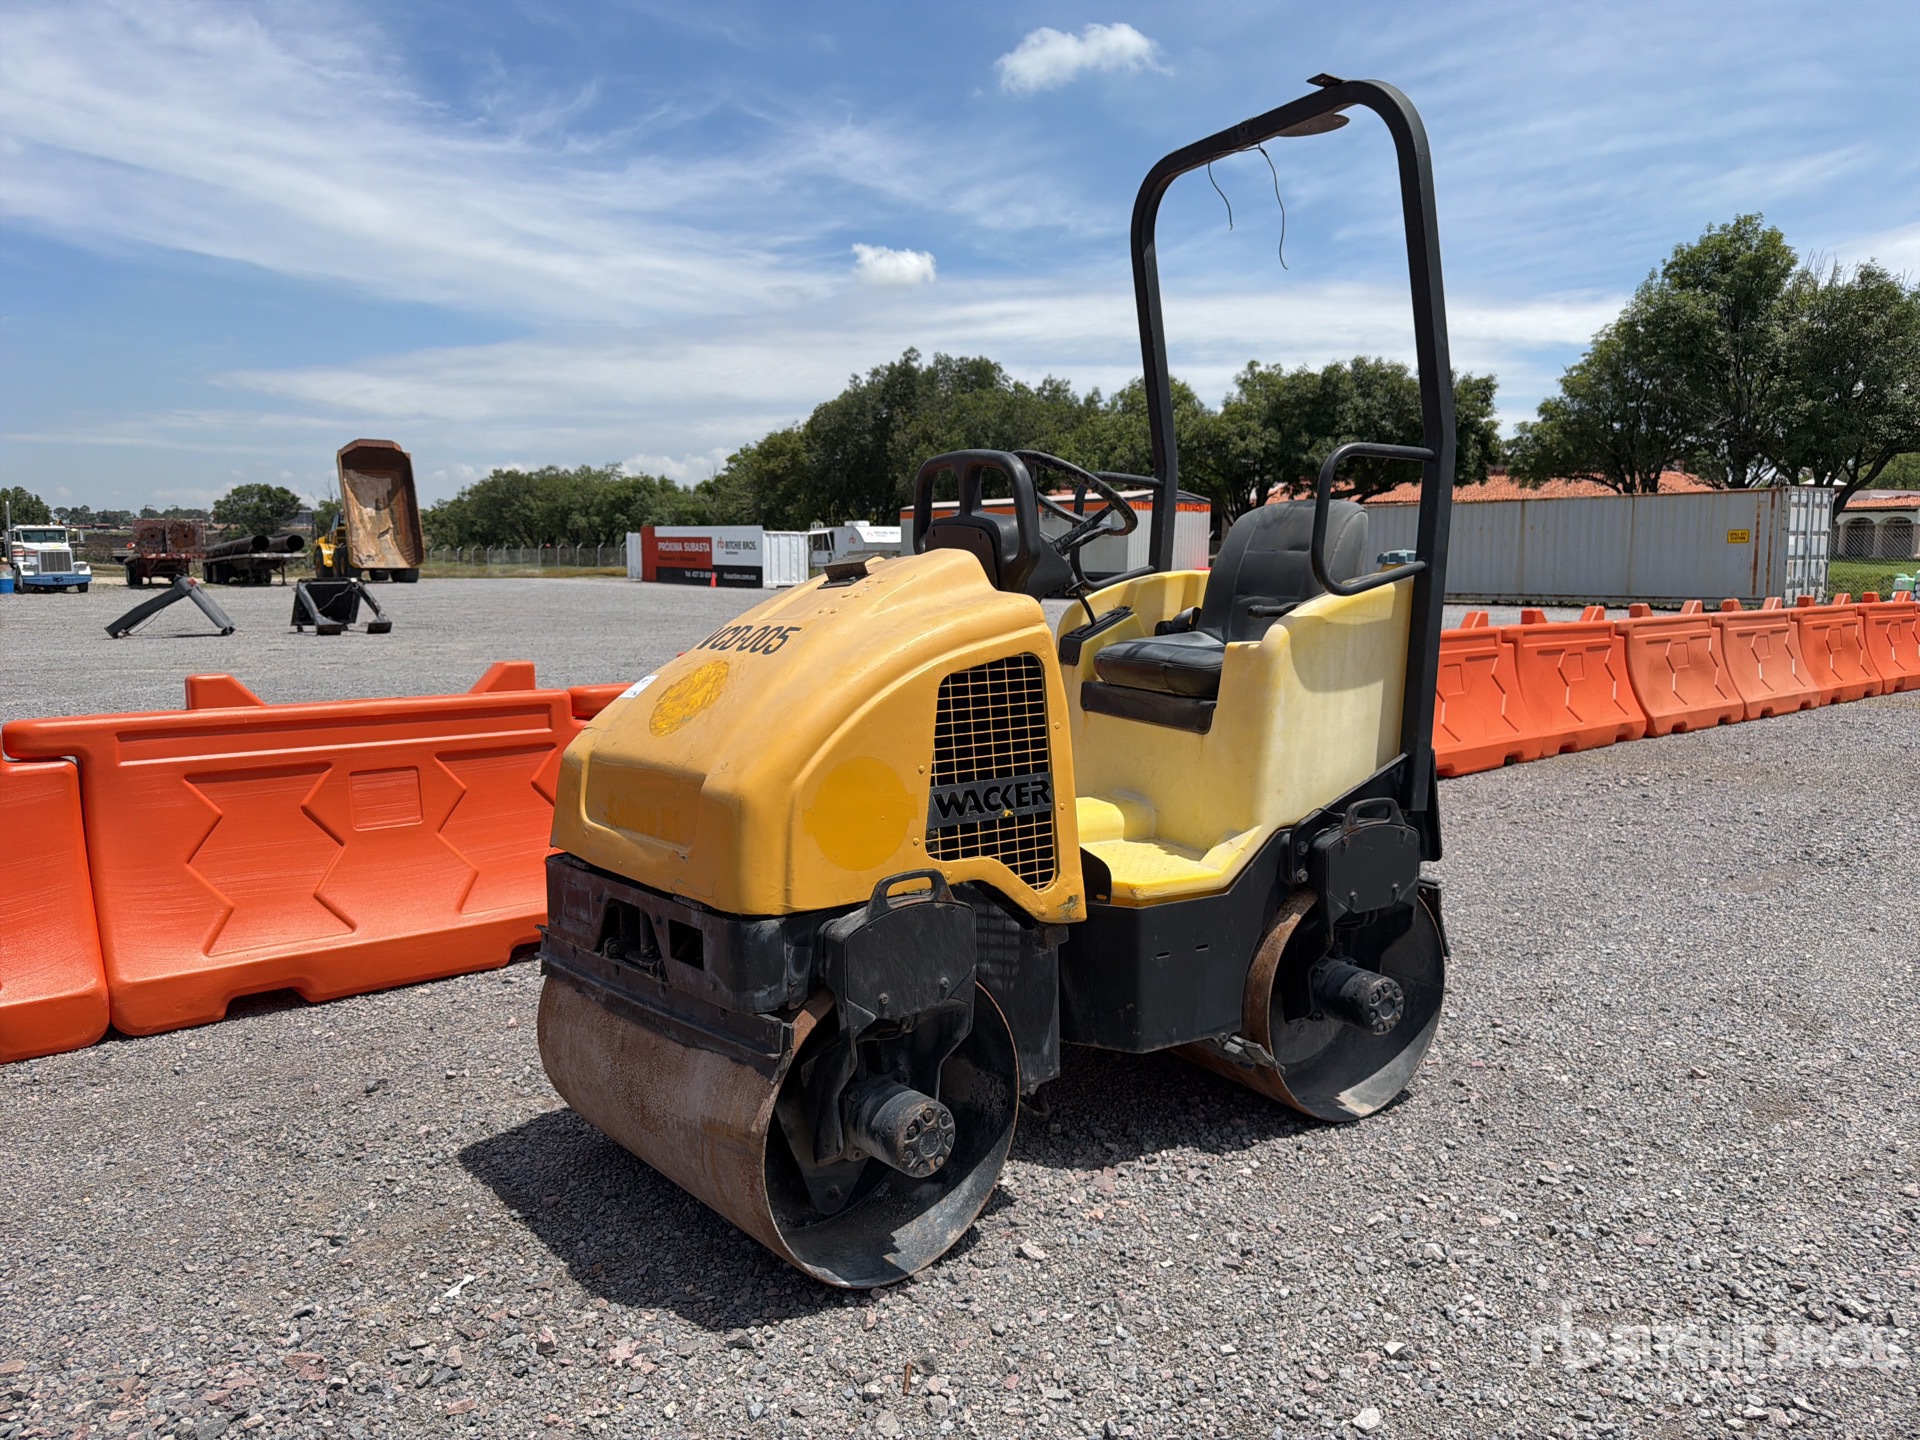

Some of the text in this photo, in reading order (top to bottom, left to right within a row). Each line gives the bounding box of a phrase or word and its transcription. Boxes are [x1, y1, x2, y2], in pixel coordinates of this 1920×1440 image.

[684, 542, 710, 552] SUBASTA
[725, 541, 741, 550] RITCHIE
[932, 780, 1052, 819] WACKER
